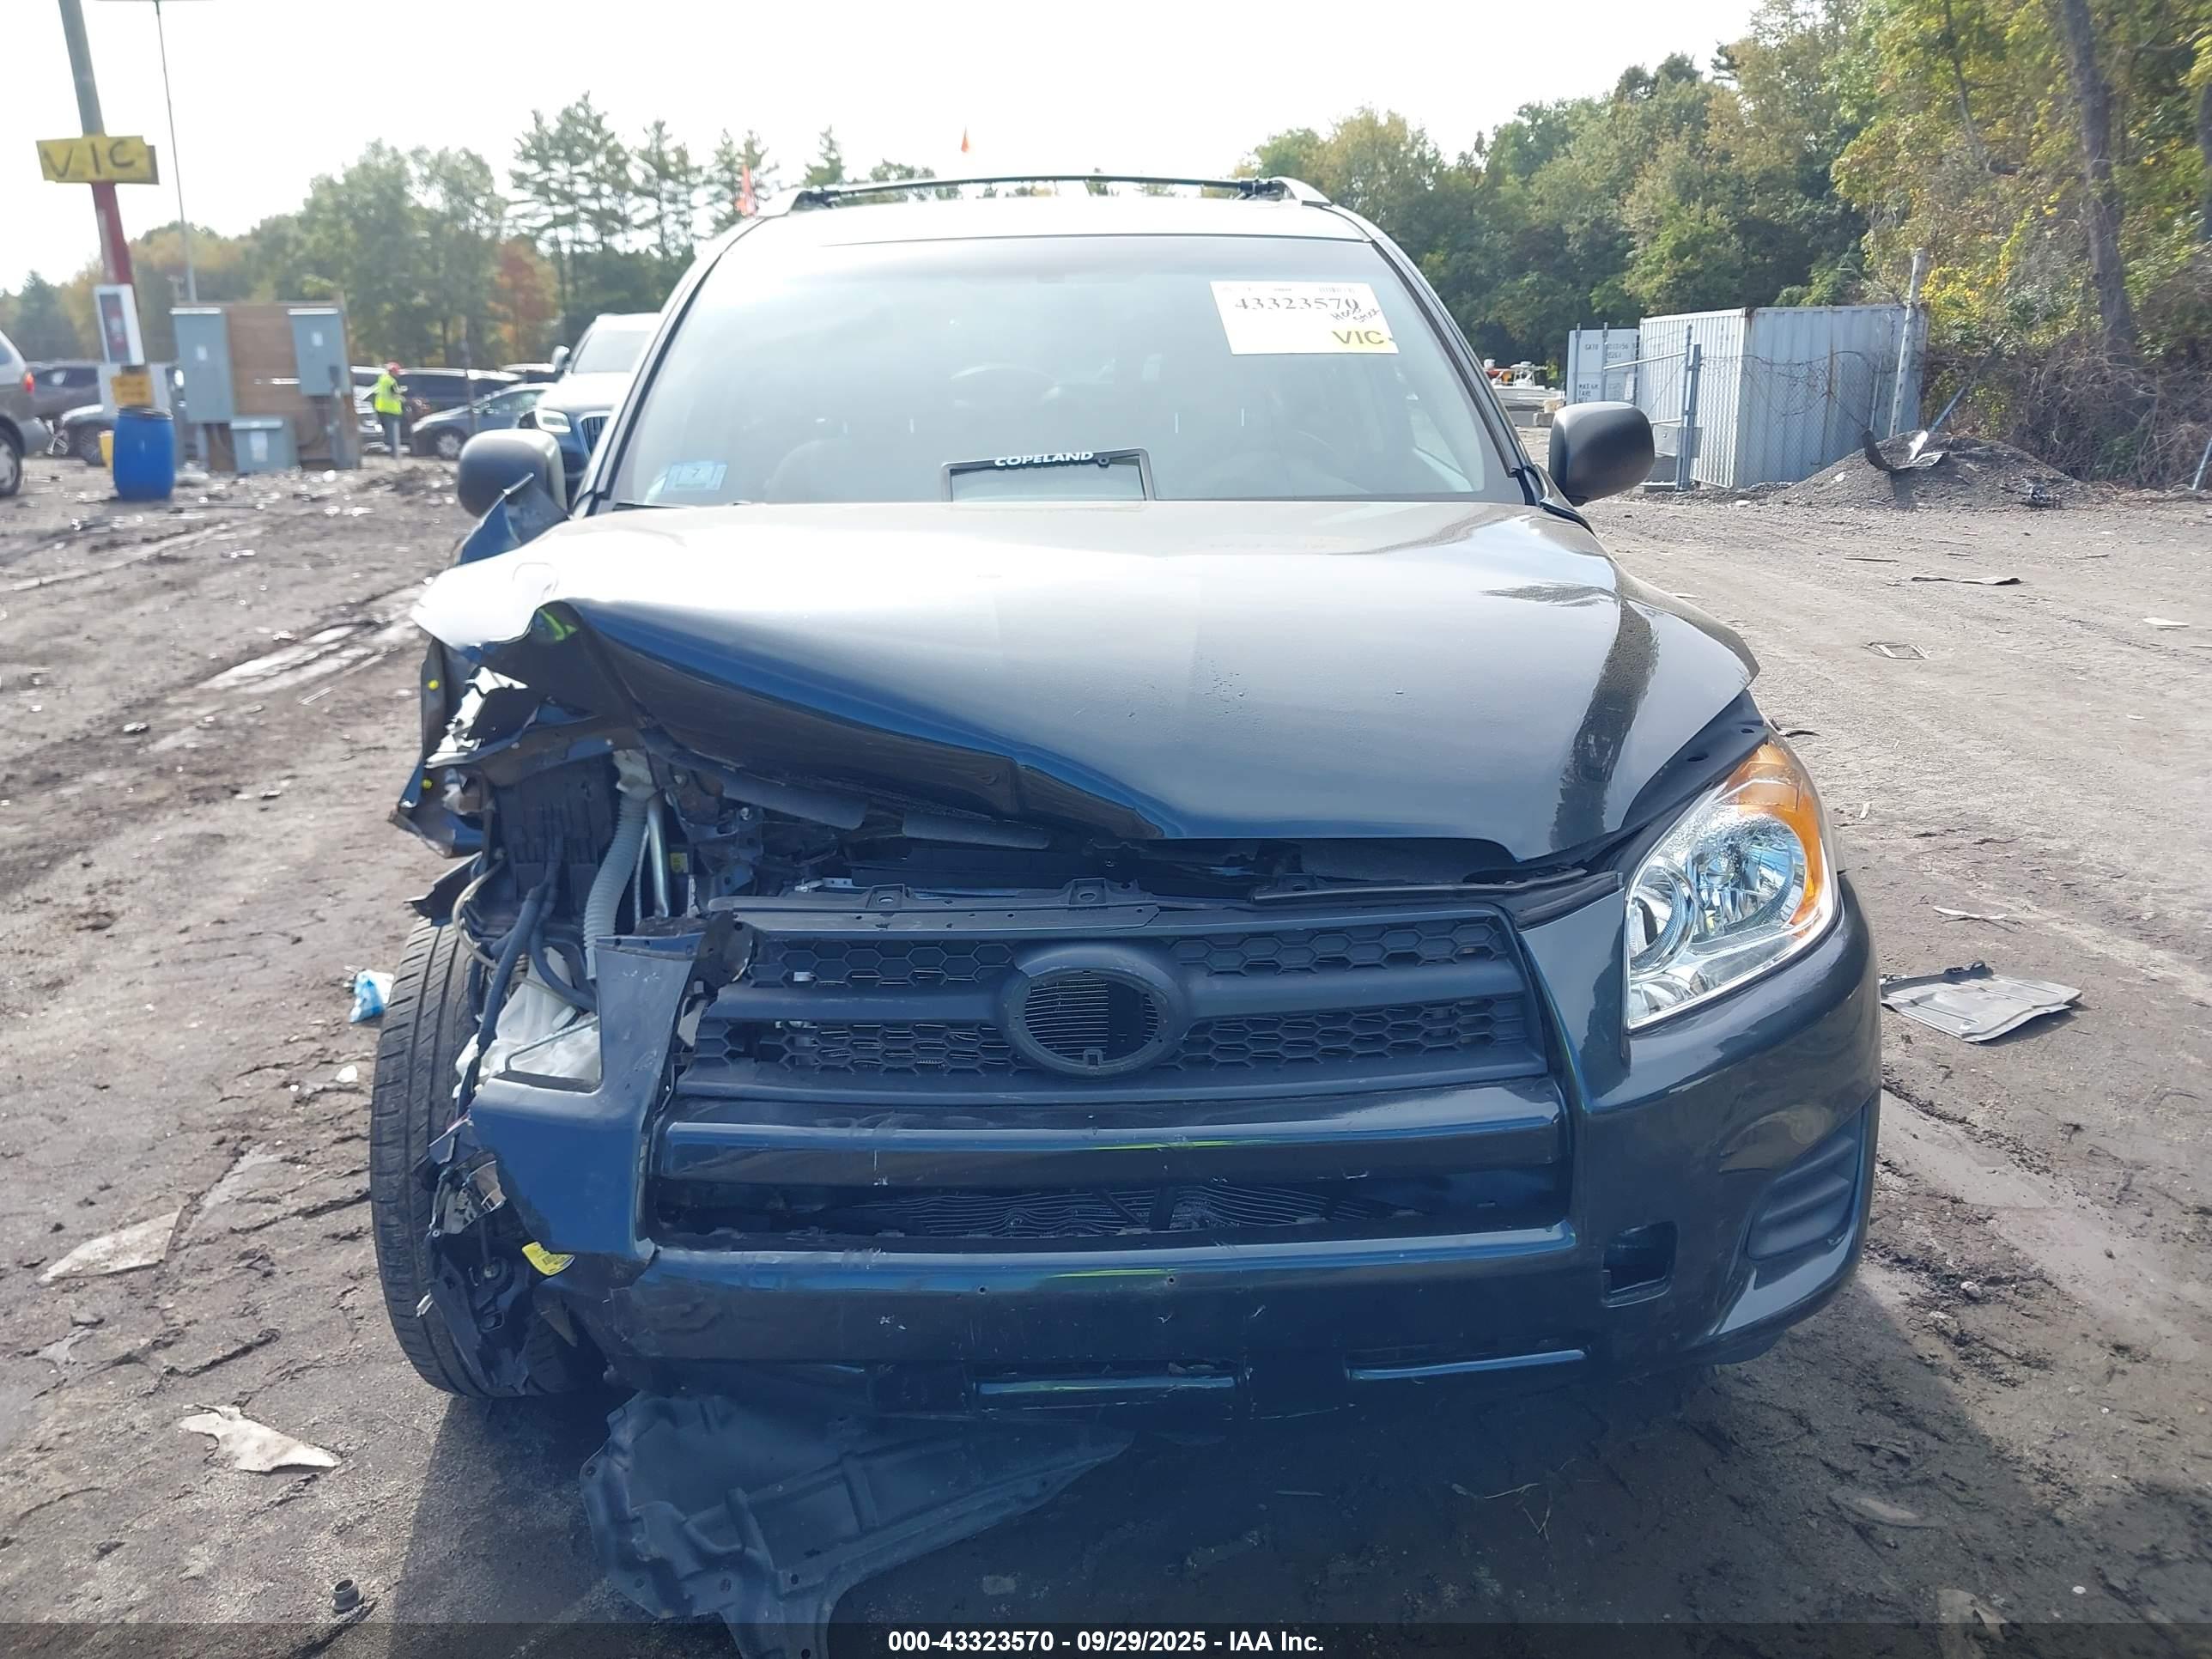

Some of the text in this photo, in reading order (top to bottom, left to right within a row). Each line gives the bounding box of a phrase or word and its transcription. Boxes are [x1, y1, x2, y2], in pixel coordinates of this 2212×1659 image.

[43, 139, 136, 178] VIC
[1235, 297, 1359, 310] 43323570
[994, 451, 1095, 467] COPELAND
